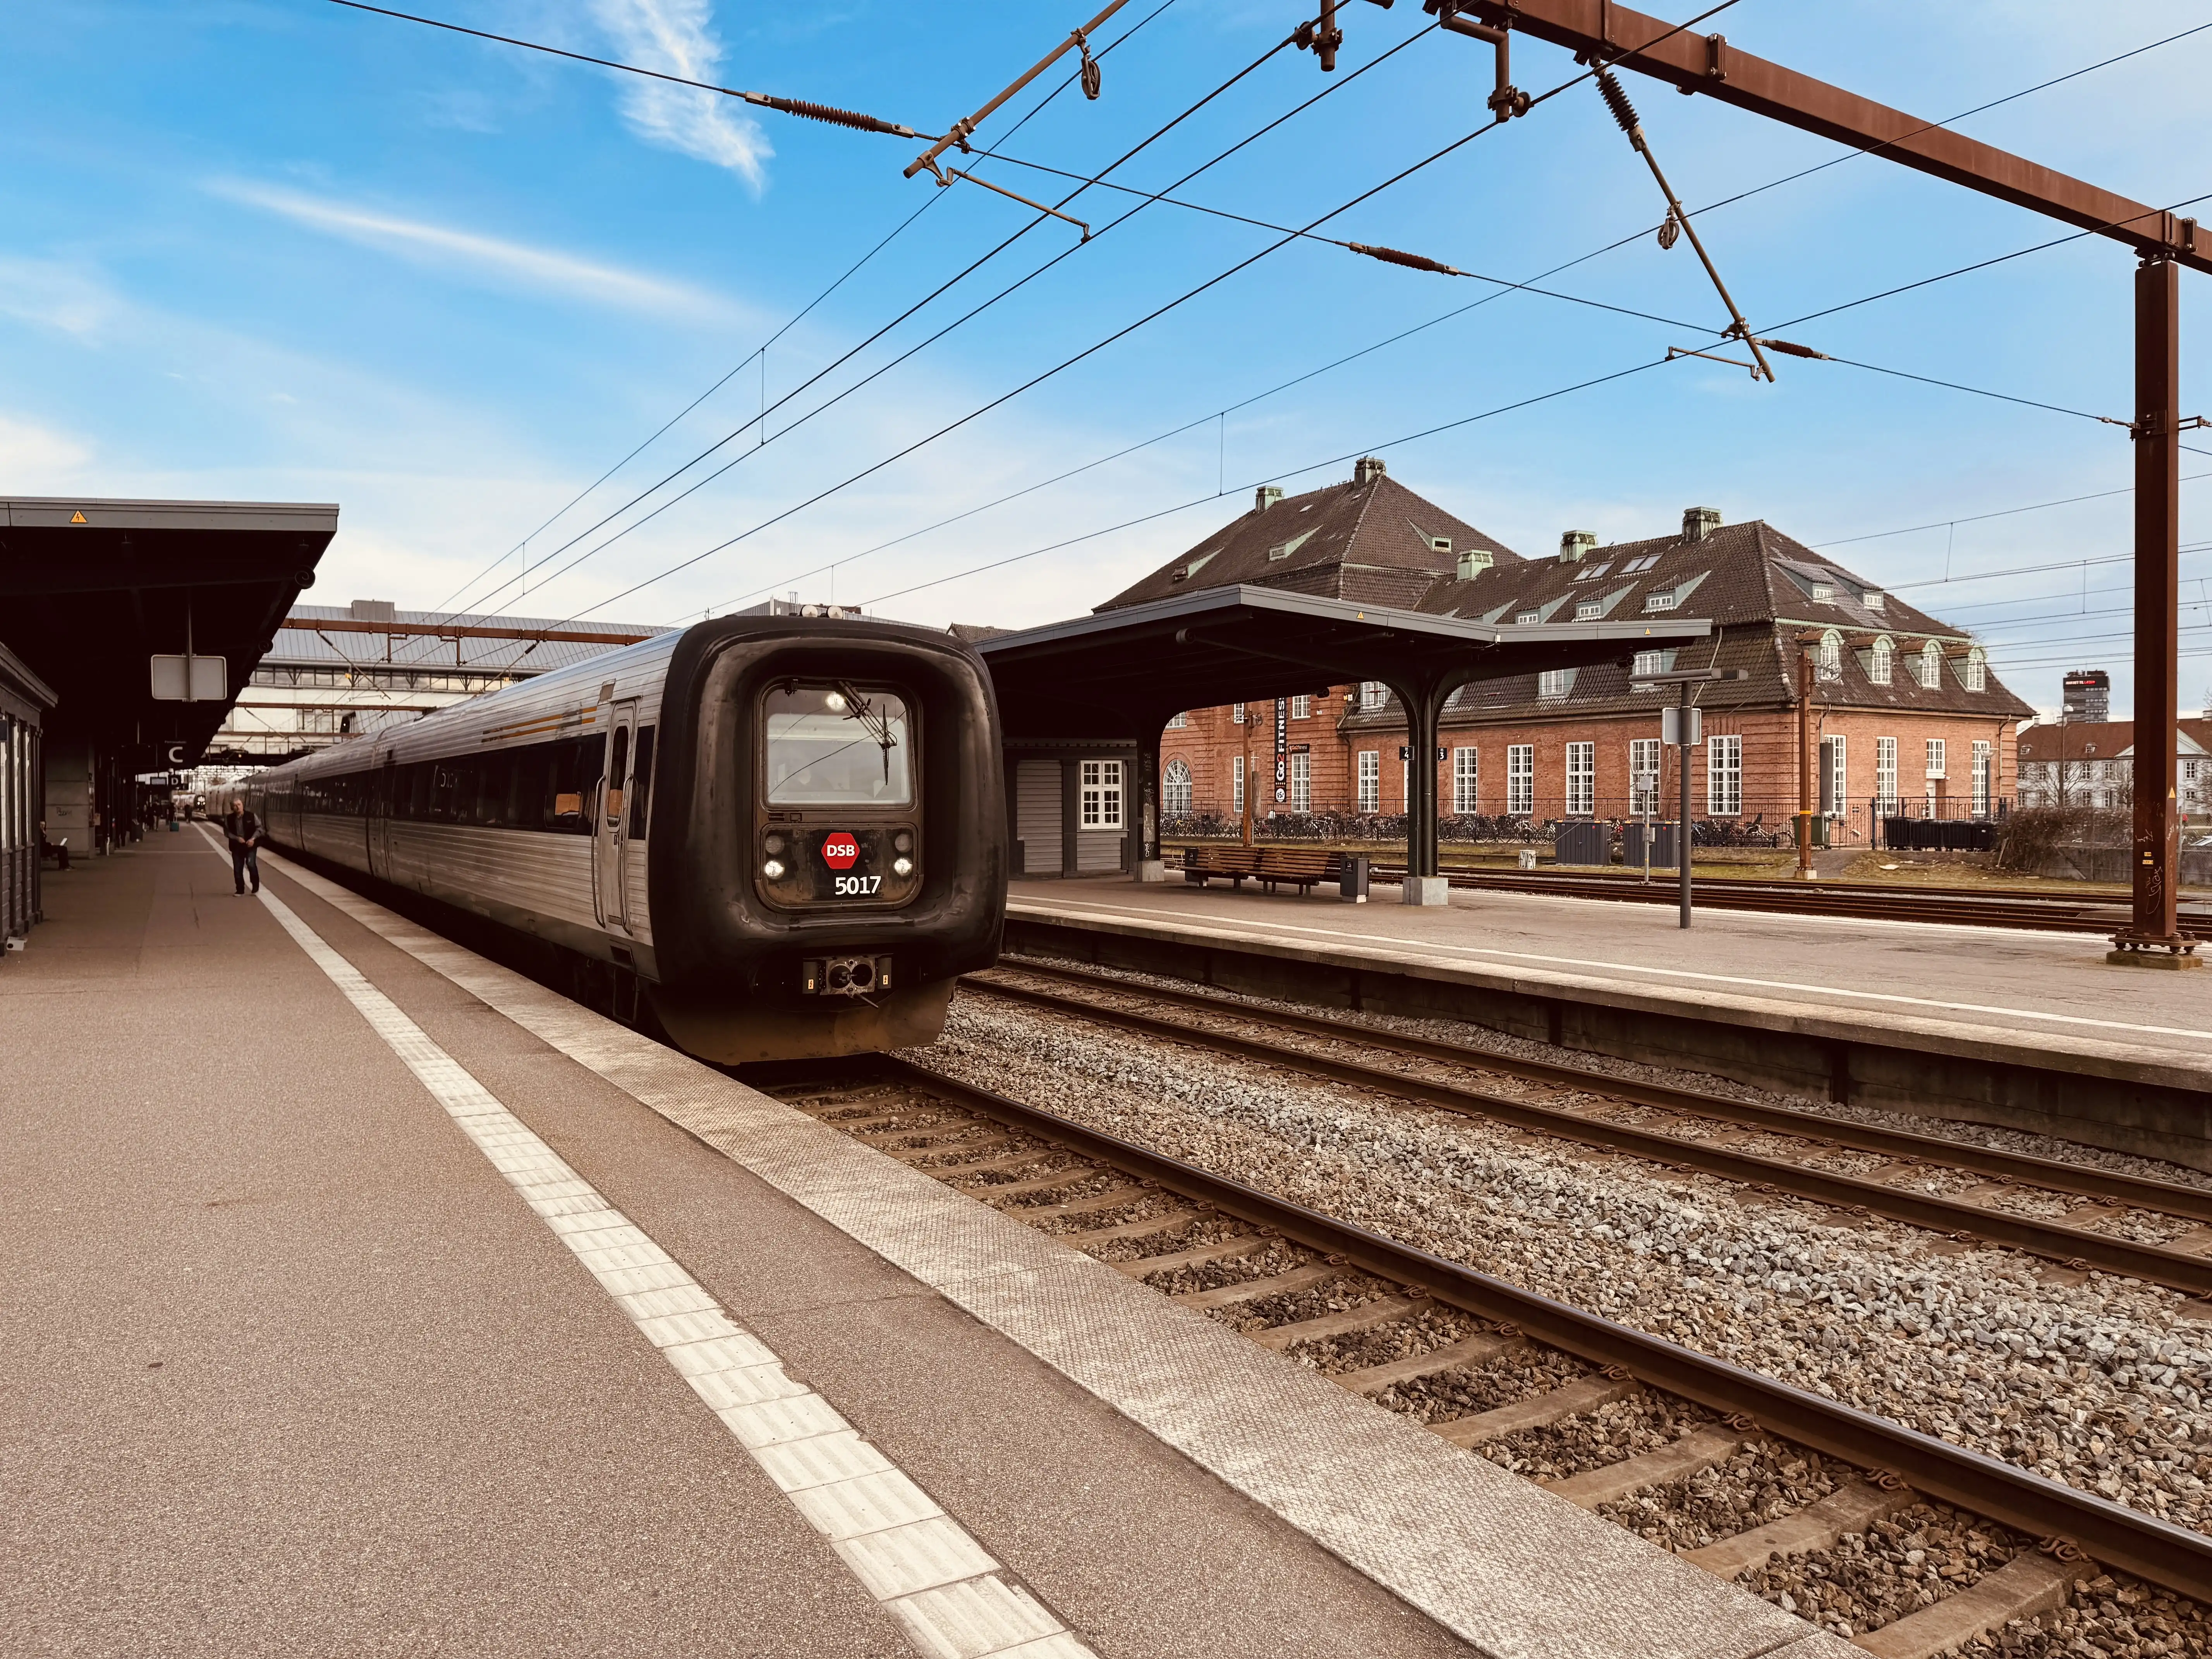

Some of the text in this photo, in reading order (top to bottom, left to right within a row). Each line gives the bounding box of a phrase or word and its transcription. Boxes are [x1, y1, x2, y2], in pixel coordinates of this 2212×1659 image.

[1276, 697, 1285, 781] GO2FITNES
[168, 746, 183, 763] C
[171, 777, 179, 785] D
[827, 845, 855, 857] DSB
[835, 876, 881, 895] 5017
